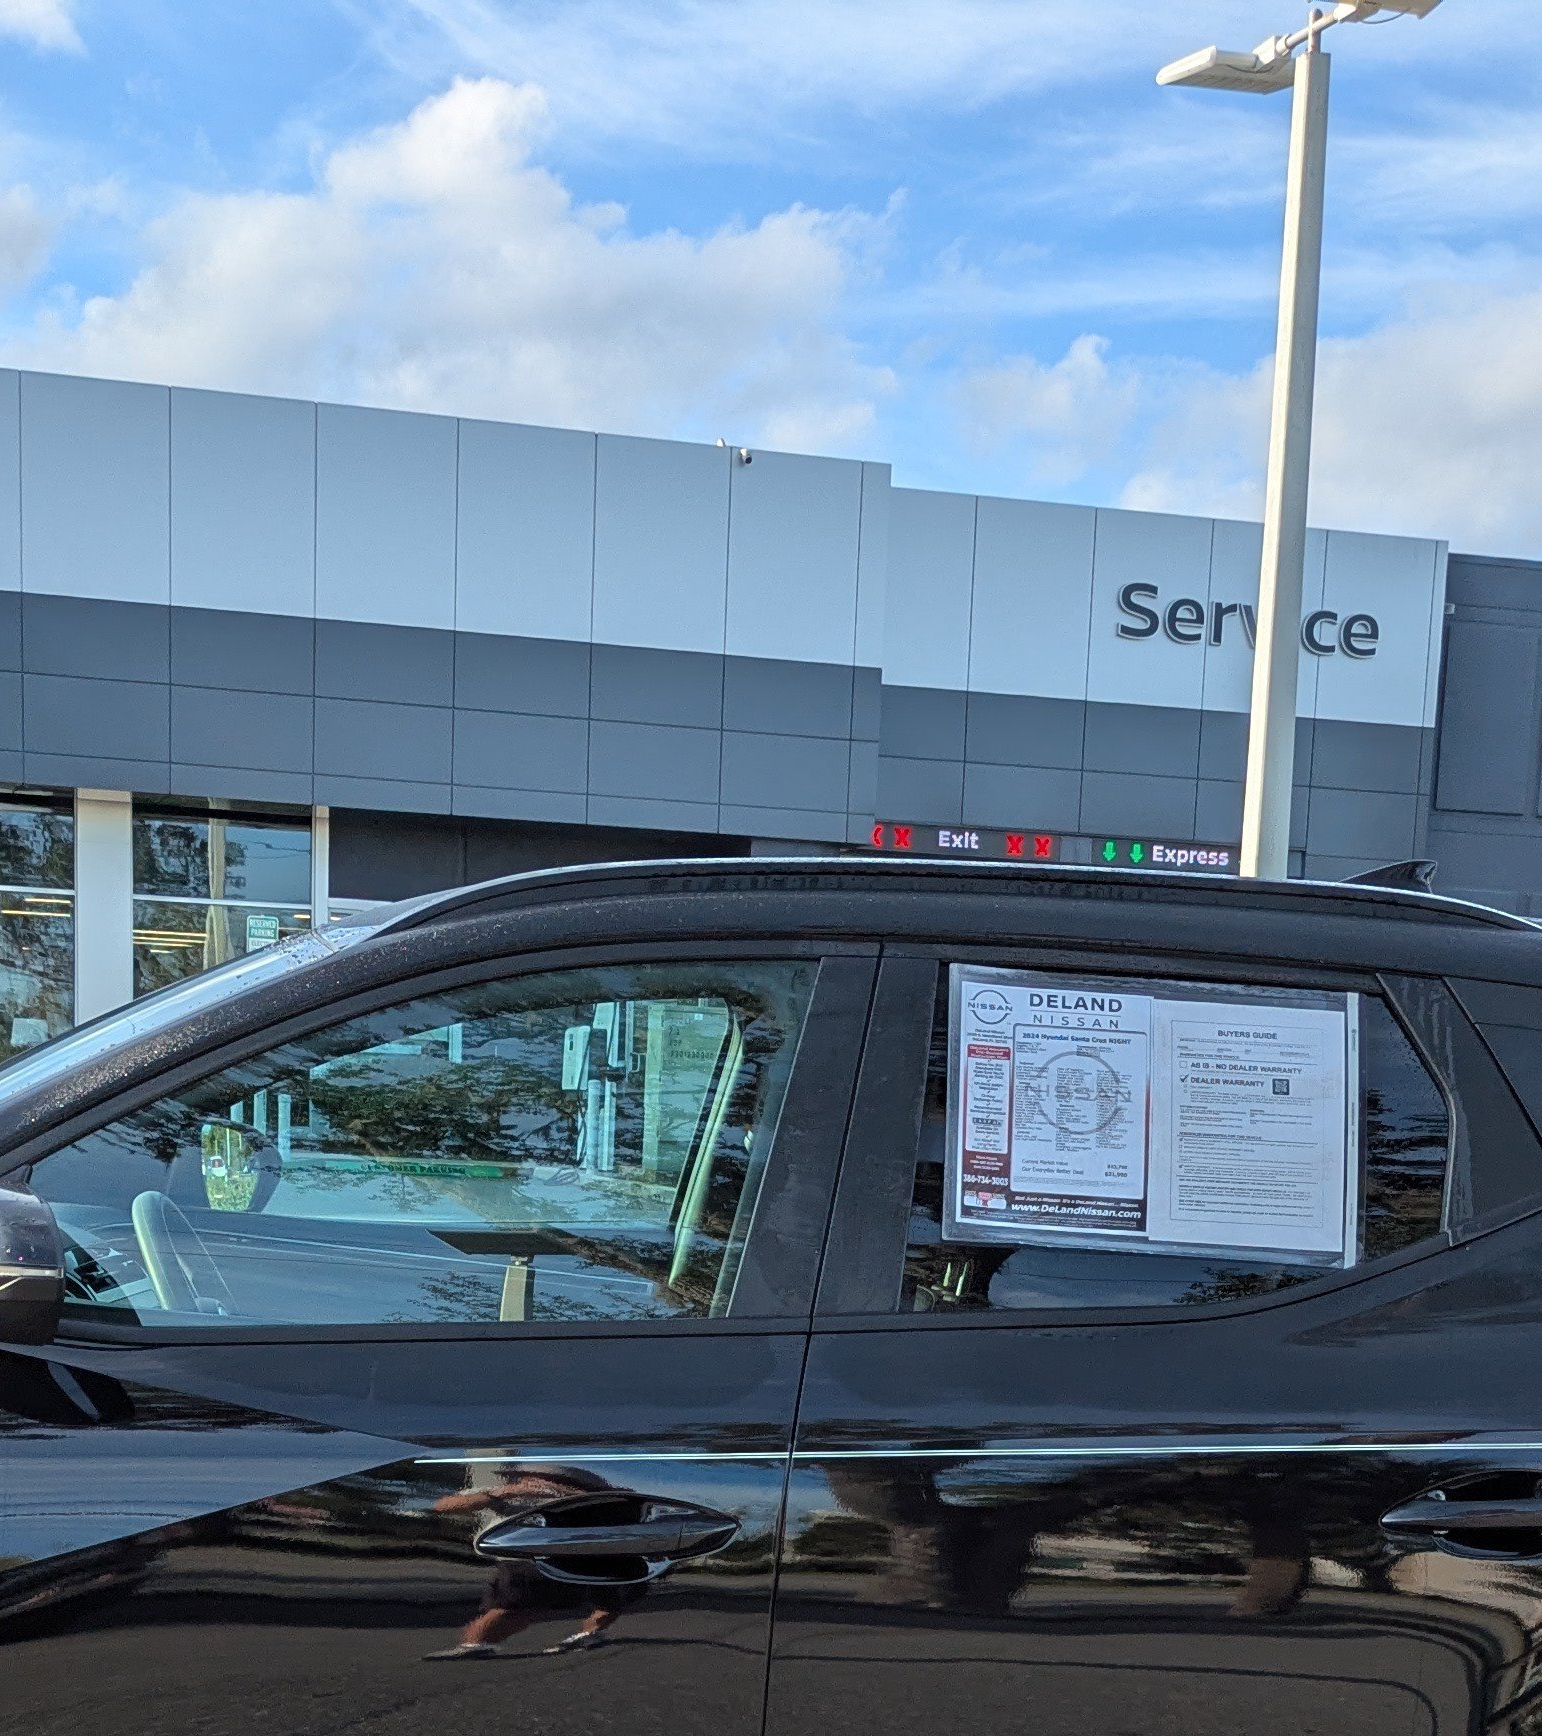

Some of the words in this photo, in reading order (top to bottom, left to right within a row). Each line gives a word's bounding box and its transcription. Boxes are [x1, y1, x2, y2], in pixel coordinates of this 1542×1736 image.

[1117, 582, 1380, 659] Serce
[938, 830, 979, 849] Exit
[1152, 845, 1230, 867] Express
[967, 1002, 1013, 1013] NISSAN
[1029, 993, 1123, 1013] DELAND
[1033, 1014, 1119, 1029] NISSAN
[1041, 1033, 1069, 1041] Hyundai
[1217, 1029, 1251, 1039] BUYERS
[1252, 1031, 1278, 1040] GUIDE
[1228, 1064, 1259, 1073] DEALER
[1260, 1066, 1302, 1075] WARRANTY
[1190, 1076, 1221, 1085] DEALER
[1222, 1078, 1265, 1088] WARRANTY
[1011, 1203, 1142, 1219] www.DeLandNissan.com
